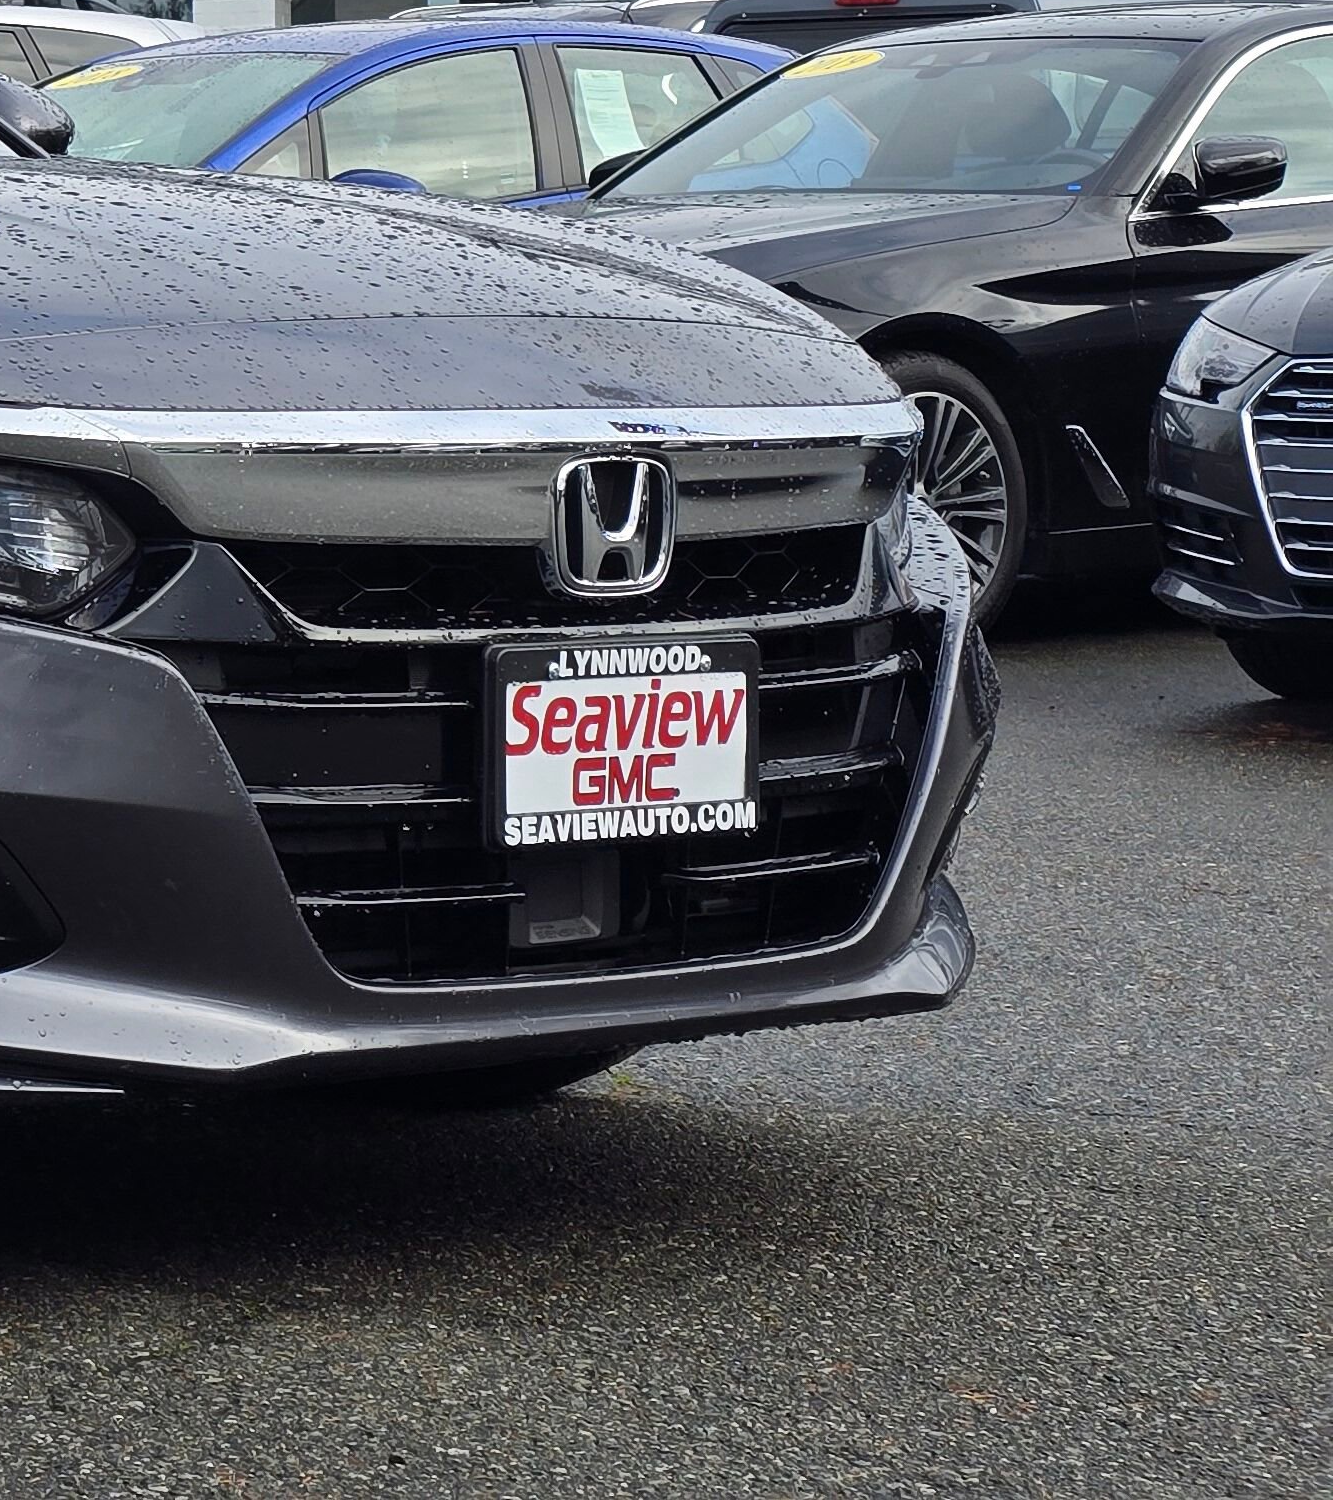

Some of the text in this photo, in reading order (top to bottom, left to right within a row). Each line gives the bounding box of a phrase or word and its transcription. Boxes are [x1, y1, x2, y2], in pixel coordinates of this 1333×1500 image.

[558, 645, 702, 677] LYNNWOOD
[505, 678, 745, 756] Seaview
[572, 752, 676, 806] GMC
[503, 801, 756, 846] SEAVIEWAUTO.COM
